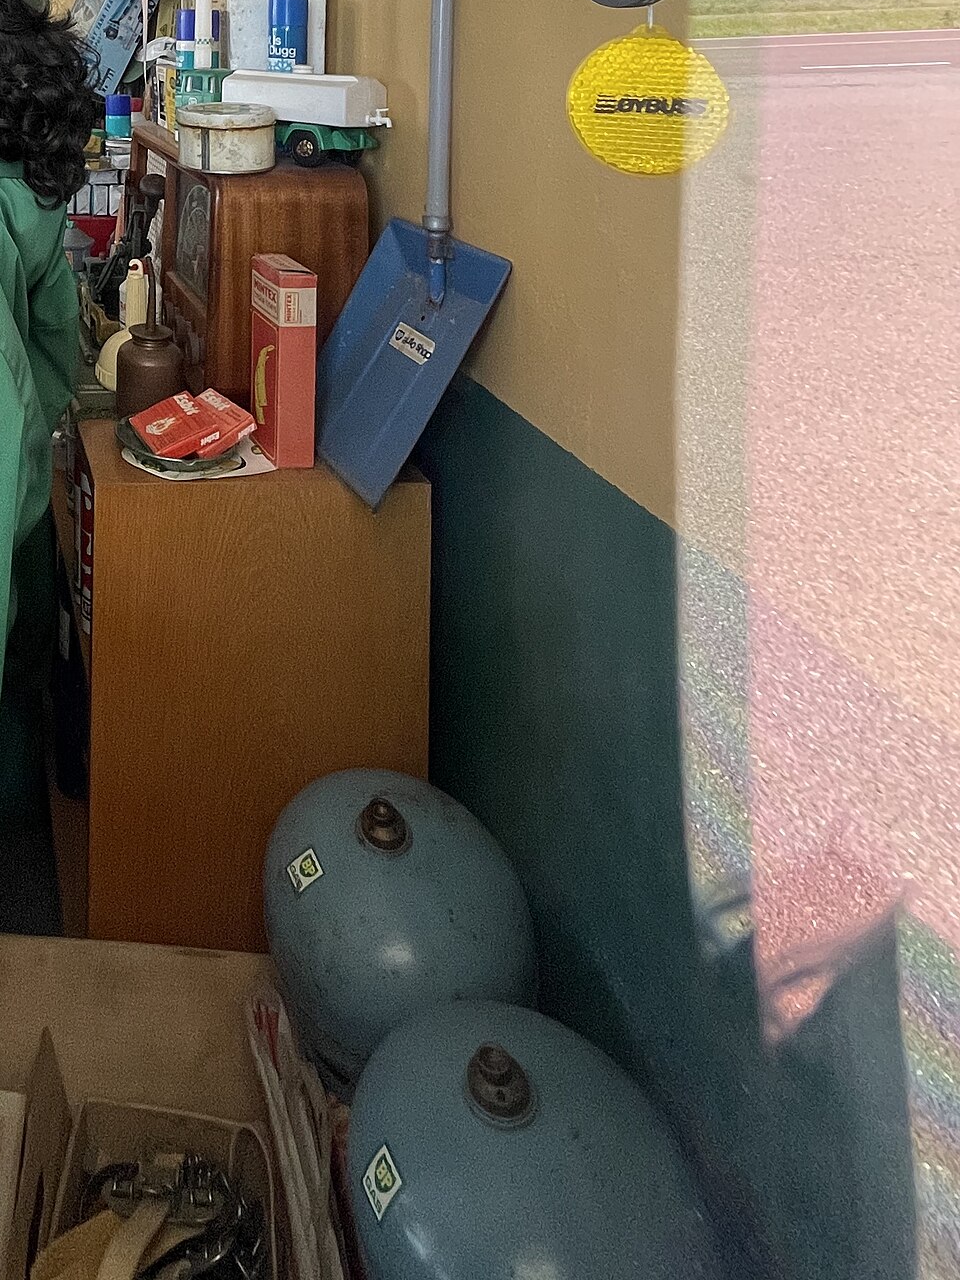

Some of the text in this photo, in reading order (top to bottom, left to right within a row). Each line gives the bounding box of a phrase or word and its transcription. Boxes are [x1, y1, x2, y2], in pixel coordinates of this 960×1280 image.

[269, 45, 297, 59] Dugg
[301, 857, 316, 875] BP
[376, 1158, 394, 1188] BP
